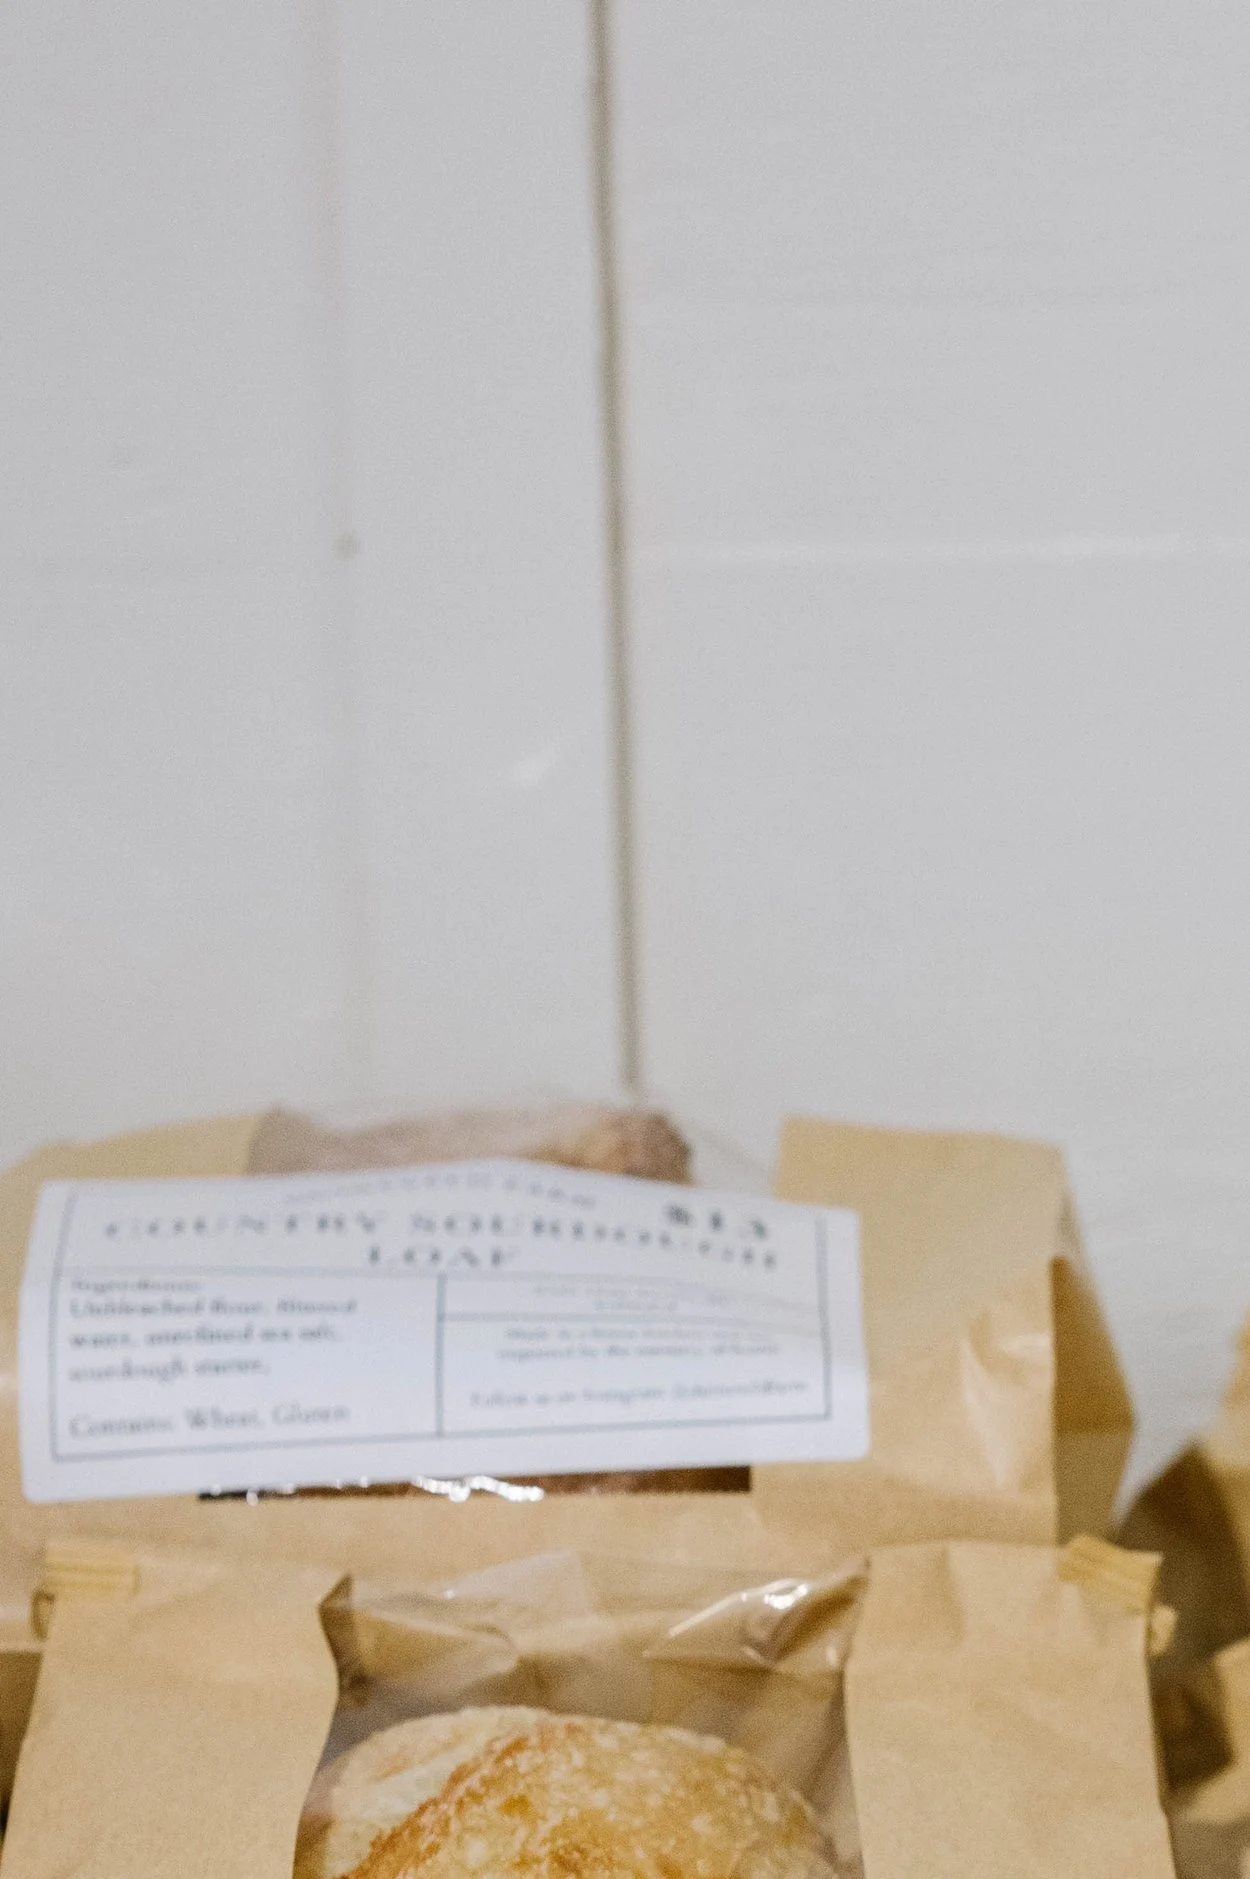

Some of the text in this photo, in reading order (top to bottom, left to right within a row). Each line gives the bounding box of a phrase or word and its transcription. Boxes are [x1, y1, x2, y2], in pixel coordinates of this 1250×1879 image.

[104, 1207, 776, 1270] COUNTRY SOURDOUGH
[366, 1244, 521, 1269] LOAF
